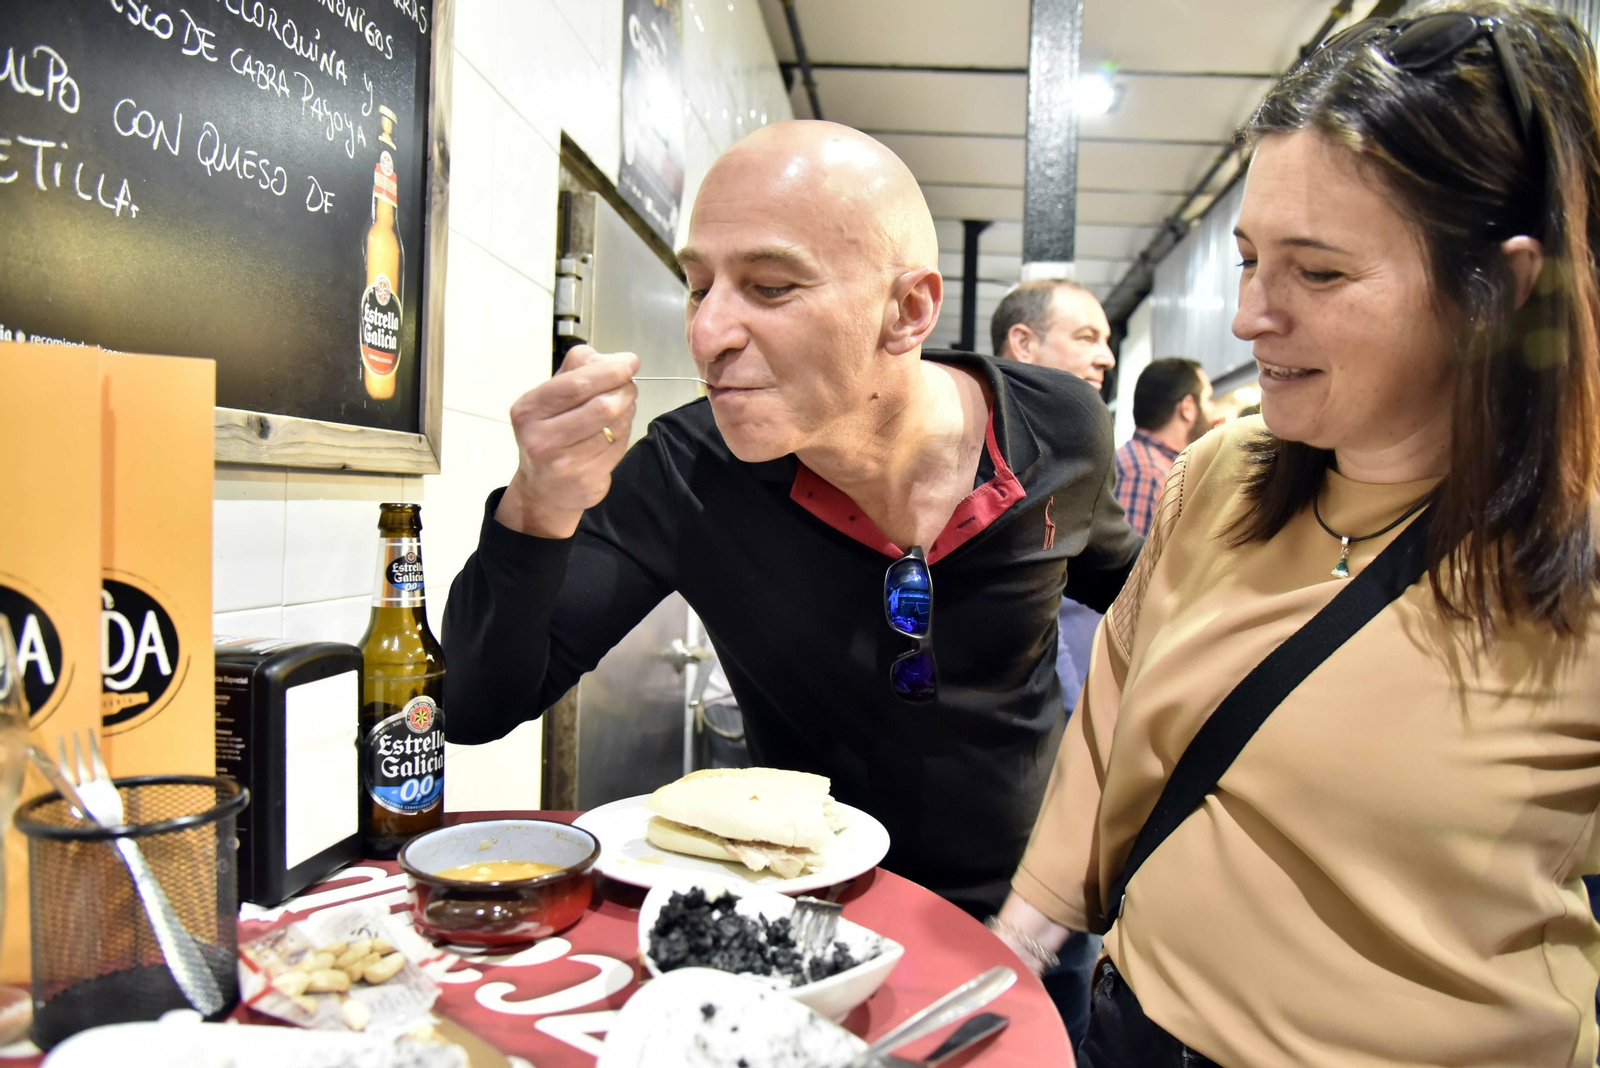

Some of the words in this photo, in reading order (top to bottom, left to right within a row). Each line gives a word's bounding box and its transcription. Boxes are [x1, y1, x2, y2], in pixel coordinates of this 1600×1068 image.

[180, 9, 218, 61] DE
[230, 48, 290, 98] CABRA
[114, 98, 183, 156] CON
[197, 121, 288, 196] QUESO
[306, 175, 335, 214] DE
[363, 303, 398, 331] Estrella
[364, 323, 397, 350] Galicia
[377, 729, 445, 756] Estrella
[381, 751, 444, 778] Galicia
[400, 774, 434, 803] 0,0
